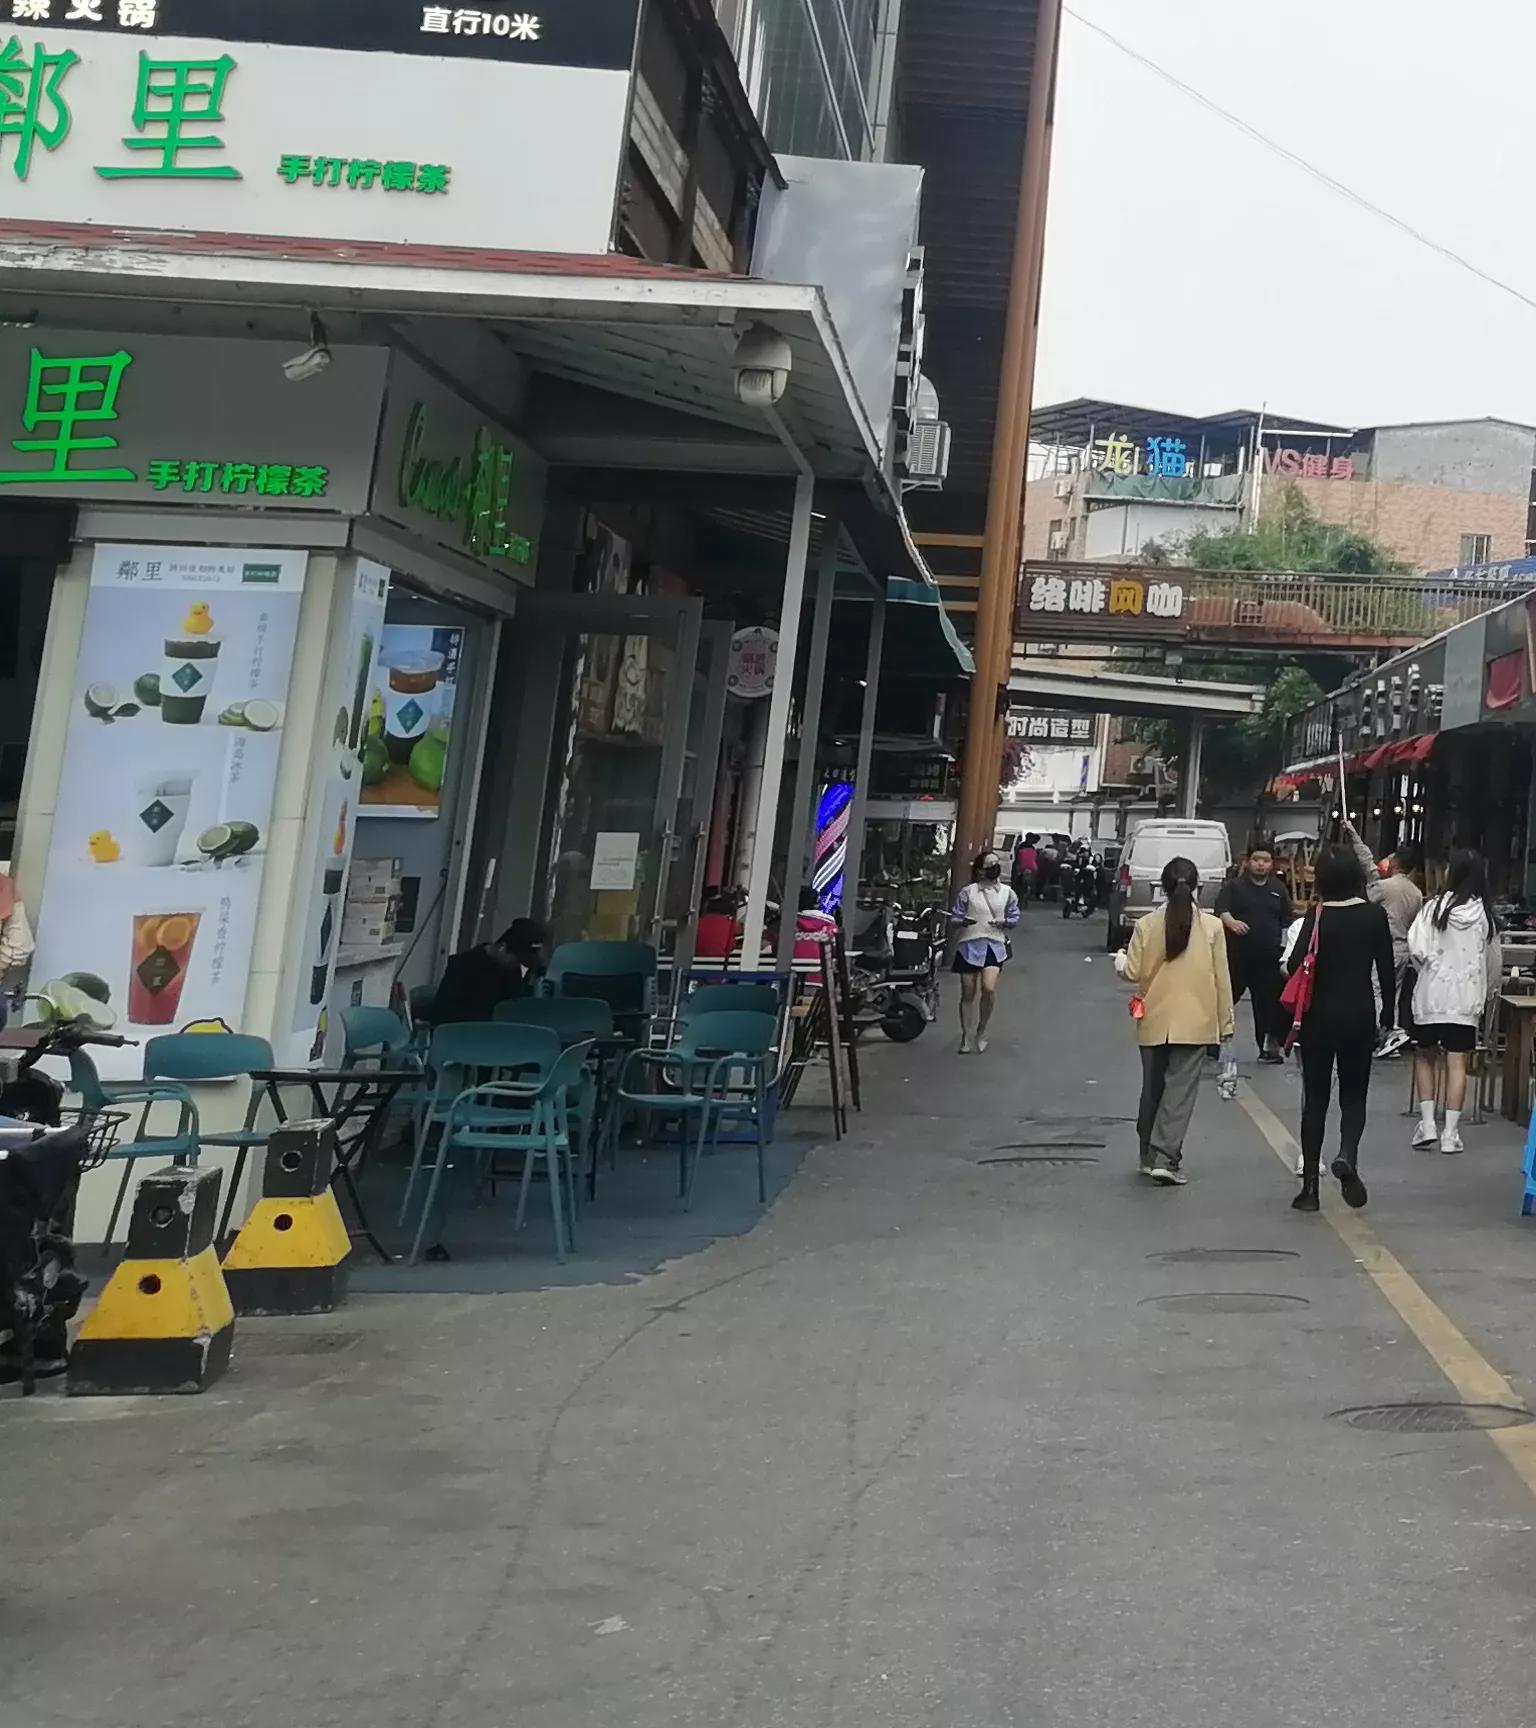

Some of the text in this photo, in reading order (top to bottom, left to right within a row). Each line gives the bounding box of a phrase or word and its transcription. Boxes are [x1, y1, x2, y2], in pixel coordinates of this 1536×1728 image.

[420, 4, 540, 43] 直行10米
[277, 154, 451, 196] 手打柠檬茶
[12, 346, 134, 483] 里
[1095, 433, 1188, 479] 龙猫
[1263, 447, 1355, 481] VS健身
[147, 458, 330, 499] 手打柠檬茶
[1030, 576, 1184, 619] 络啡网咖
[1007, 715, 1091, 740] 时尚造型
